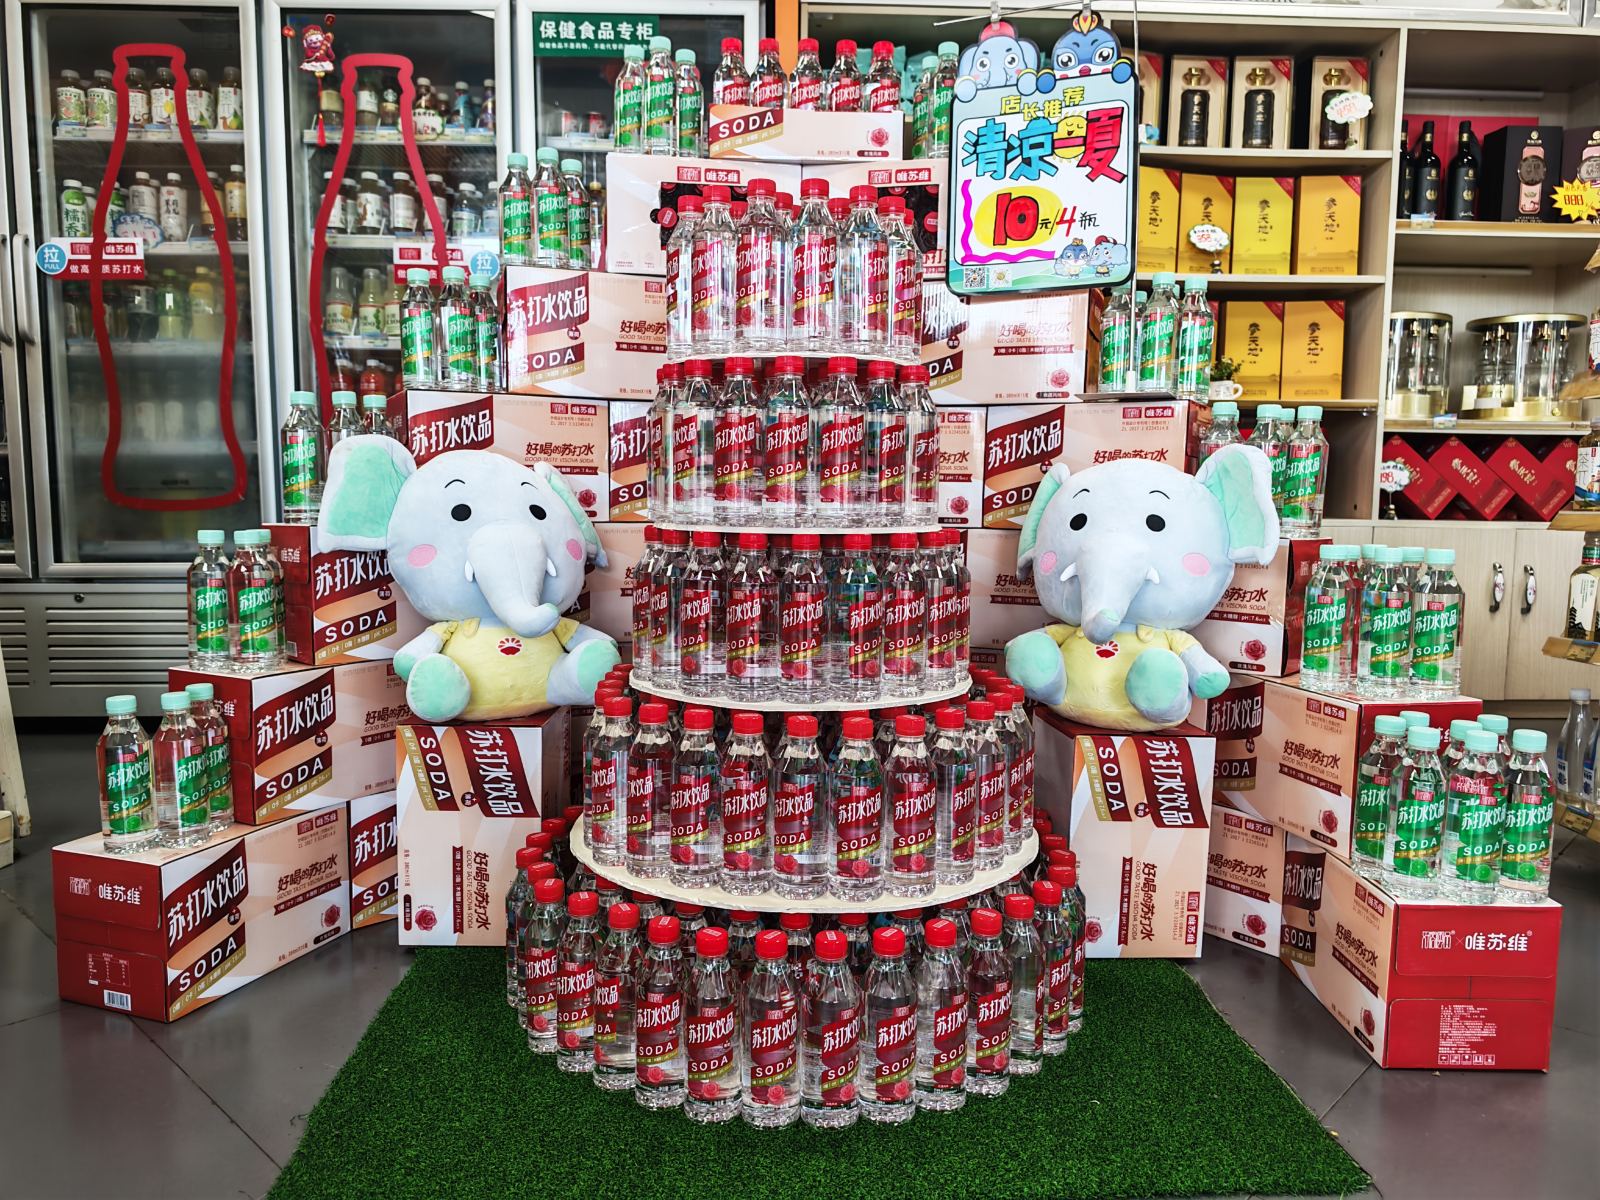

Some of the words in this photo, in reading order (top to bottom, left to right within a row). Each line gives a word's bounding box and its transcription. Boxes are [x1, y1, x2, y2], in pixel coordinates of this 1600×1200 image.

[539, 20, 654, 40] 保健食品专柜
[1000, 86, 1085, 122] 店长推荐
[718, 111, 775, 138] SODA
[961, 106, 1128, 184] 清凉一夏
[706, 170, 739, 182] 唯苏维
[897, 170, 931, 182] 唯苏维
[506, 227, 531, 238] SODA
[542, 222, 566, 233] SODA
[44, 247, 60, 264] 拉
[105, 245, 136, 255] 唯苏维
[476, 253, 493, 270] 拉
[793, 243, 837, 274] 苏打水饮品
[69, 264, 143, 274] 做高质苏打水
[736, 283, 764, 300] SODA
[796, 284, 831, 300] SODA
[508, 285, 587, 330] 苏打水饮品
[519, 348, 576, 373] SODA
[930, 360, 954, 378] DA
[572, 407, 596, 415] 唯苏维
[1146, 408, 1173, 417] 唯苏维
[411, 408, 493, 456] 苏打水饮品
[715, 420, 755, 453] 苏打水饮品
[766, 421, 808, 453] 苏打水饮品
[821, 423, 864, 453] 苏打水饮品
[526, 441, 595, 457] 好喝的苏打水
[988, 419, 1062, 471] 苏打水饮品
[285, 473, 313, 486] SODA
[716, 460, 749, 477] SODA
[769, 461, 803, 478] SODA
[824, 461, 858, 479] SODA
[992, 487, 1033, 509] SOD
[1283, 486, 1314, 499] SODA
[782, 600, 823, 628] 苏打水饮品
[885, 597, 925, 627] 苏打水饮品
[1306, 602, 1345, 626] 苏打水饮品
[1372, 606, 1412, 632] 苏打水饮品
[1414, 609, 1457, 633] 苏打水饮品
[244, 617, 274, 633] SODA
[325, 609, 387, 643] SODA
[727, 636, 755, 651] SODA
[784, 638, 817, 654] SODA
[888, 634, 921, 651] SODA
[1306, 636, 1338, 648] SODA
[1375, 640, 1408, 654] SODA
[1416, 642, 1450, 657] SODA
[257, 683, 335, 755] 苏打水饮品
[1210, 695, 1262, 733] 苏打水饮品
[1323, 706, 1346, 719] 唯苏维
[1283, 739, 1341, 770] 好喝的苏打水
[107, 757, 150, 789] 苏打水饮品
[266, 759, 323, 799] SODA
[419, 736, 451, 800] SODA
[465, 728, 525, 815] 苏打水饮品
[1098, 746, 1125, 811] SODA
[1213, 761, 1250, 777] SODA
[1282, 755, 1295, 764] GOOD
[1326, 768, 1339, 780] SODA
[1143, 739, 1195, 826] 苏打水饮品
[112, 792, 148, 813] SODA
[670, 783, 710, 810] 苏打水饮品
[724, 786, 767, 817] 苏打水饮品
[774, 790, 814, 818] 苏打水饮品
[837, 791, 882, 825] 苏打水饮品
[895, 787, 935, 821] 苏打水饮品
[1397, 800, 1445, 825] 苏打水饮品
[1505, 801, 1553, 830] 苏打水饮品
[672, 823, 704, 837] SODA
[727, 828, 761, 844] SODA
[775, 832, 806, 845] SODA
[898, 829, 933, 847] SODA
[1245, 819, 1272, 836] 唯苏维
[1360, 822, 1385, 832] SOD
[841, 833, 878, 852] SODA
[1399, 836, 1438, 850] SODA
[1463, 840, 1500, 857] SODA
[1506, 841, 1546, 854] SODA
[277, 853, 338, 894] 好喝的苏打水
[1208, 852, 1268, 879] 喝的苏打水
[277, 889, 292, 901] GOOD
[325, 870, 338, 881] SODA
[473, 851, 490, 931] 好喝的苏打水
[1250, 879, 1266, 889] SODA
[1283, 863, 1323, 901] 苏打水饮品
[98, 883, 141, 905] 唯苏维
[167, 855, 246, 948] 苏打水饮品
[1141, 862, 1157, 942] 好喝的苏打水
[1132, 899, 1140, 922] VISOVA
[1131, 923, 1139, 941] SODA
[1186, 917, 1198, 944] 唯苏维
[1284, 927, 1312, 950] SODA
[1465, 932, 1529, 952] 唯苏维
[1336, 921, 1378, 969] 好喝的苏打水
[179, 936, 237, 992] SODA
[558, 1009, 589, 1022] SODA
[636, 999, 680, 1028] 苏打水饮品
[688, 1011, 734, 1044] 苏打水饮品
[752, 1008, 798, 1049] 苏打水饮品
[639, 1041, 673, 1056] SODA
[691, 1055, 728, 1072] SODA
[755, 1058, 793, 1077] SODA
[881, 1052, 916, 1076] SODA
